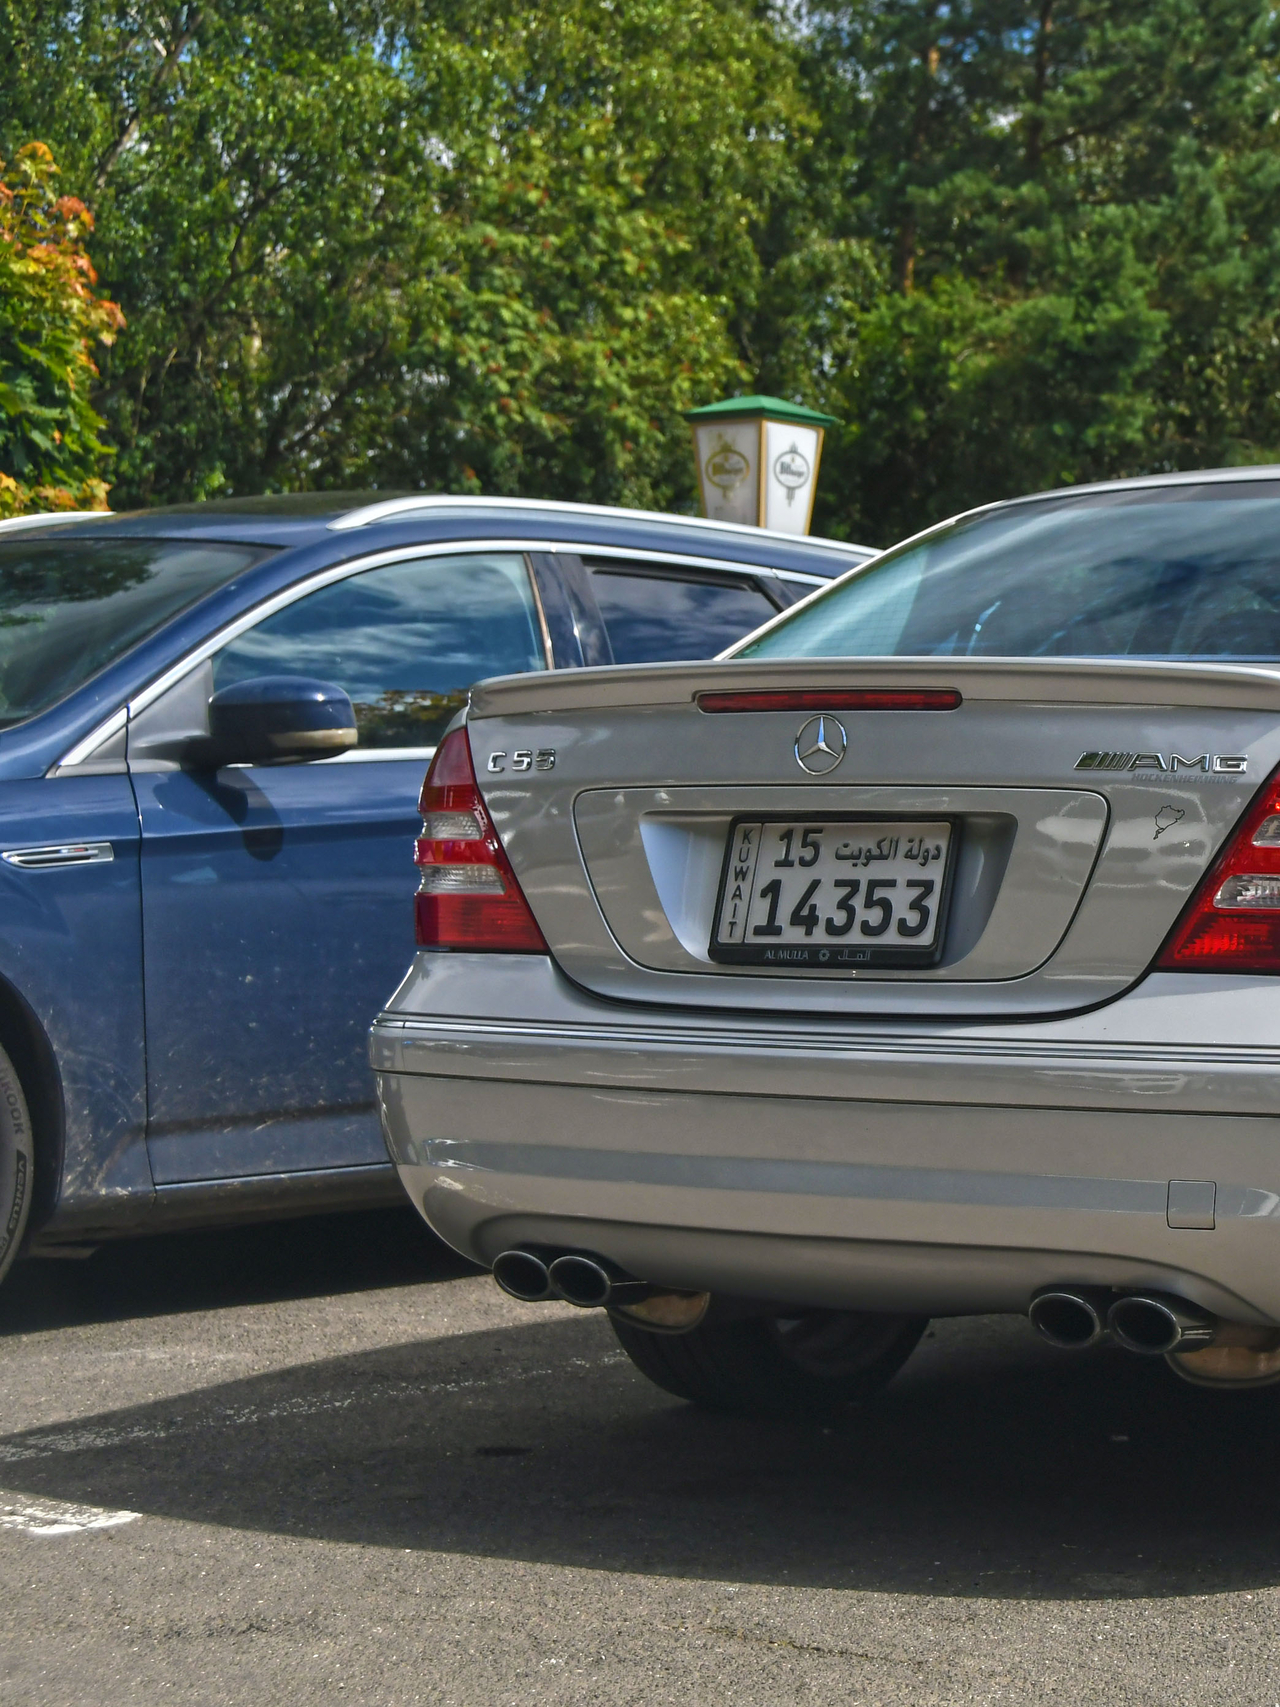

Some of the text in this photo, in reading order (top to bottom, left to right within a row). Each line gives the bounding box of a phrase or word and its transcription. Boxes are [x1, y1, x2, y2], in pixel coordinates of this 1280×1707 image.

[1127, 752, 1248, 774] AMG
[773, 828, 942, 868] 15 دولة الكويت
[728, 829, 752, 938] KUWAIT
[752, 878, 935, 937] 14353
